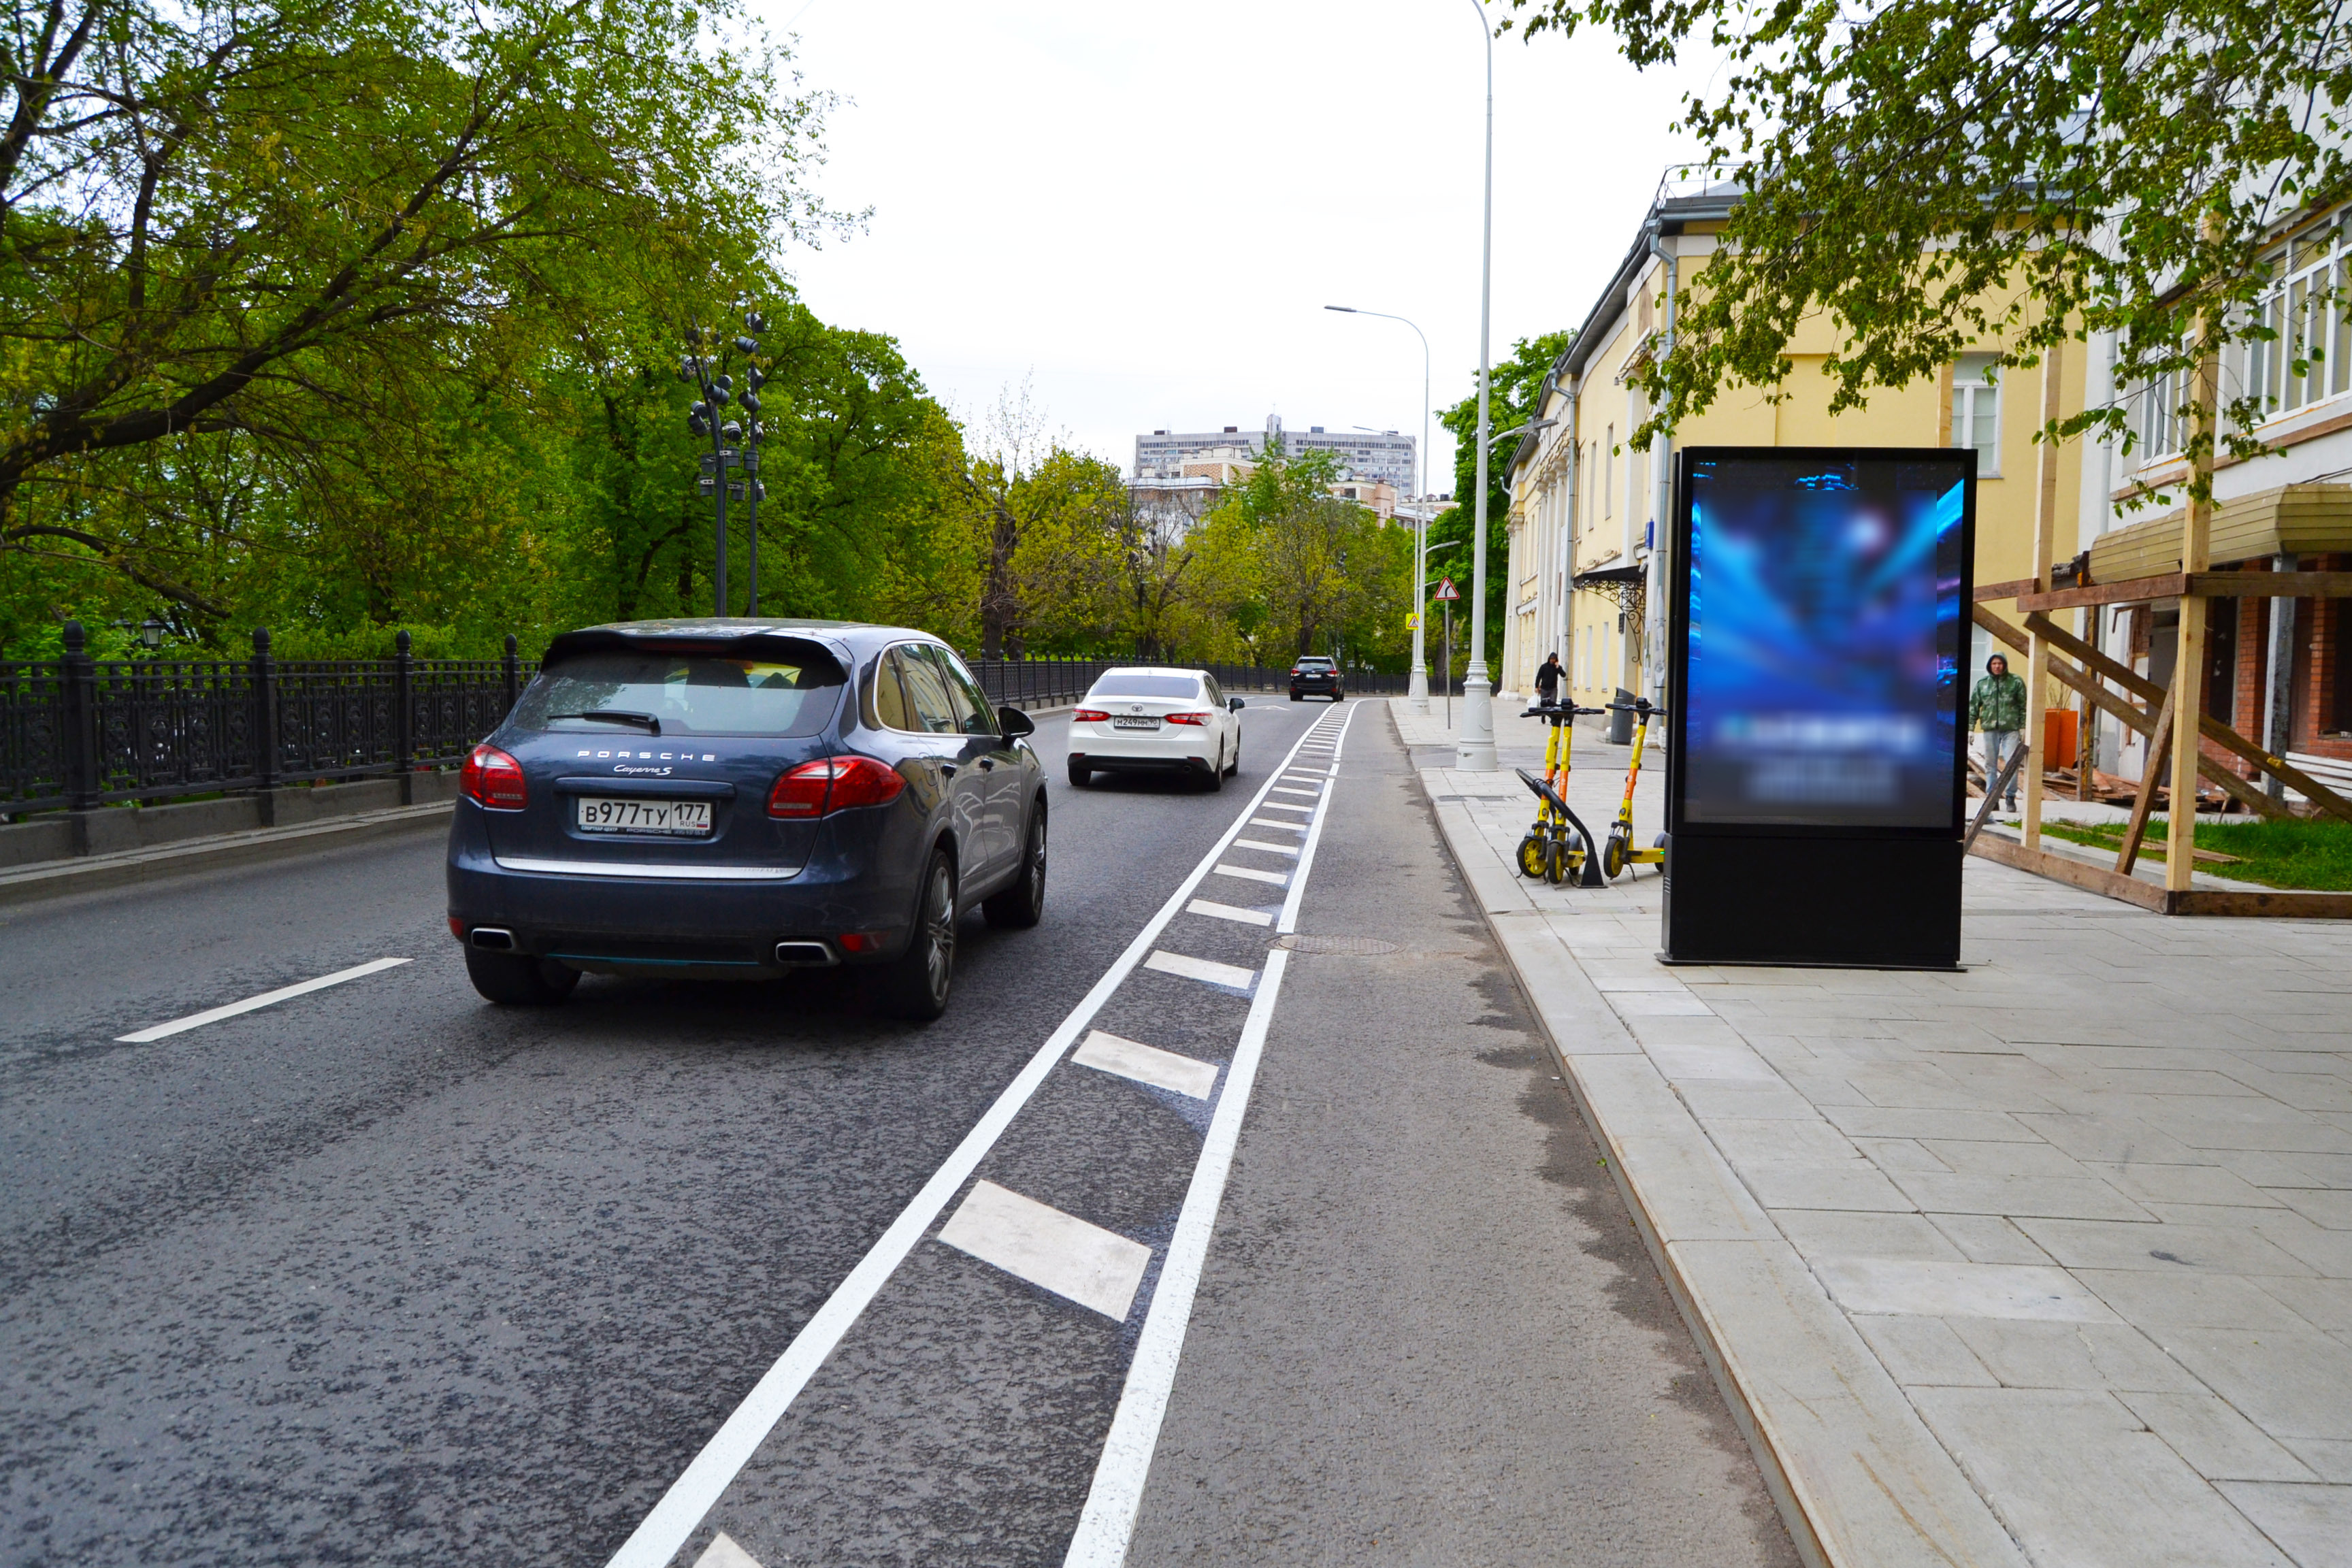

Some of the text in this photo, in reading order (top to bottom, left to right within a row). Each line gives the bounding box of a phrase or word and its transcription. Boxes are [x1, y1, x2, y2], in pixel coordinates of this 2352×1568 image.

[577, 751, 715, 762] PORSCHE
[613, 764, 672, 776] Cayenne S
[586, 802, 706, 826] В977ТУ 177
